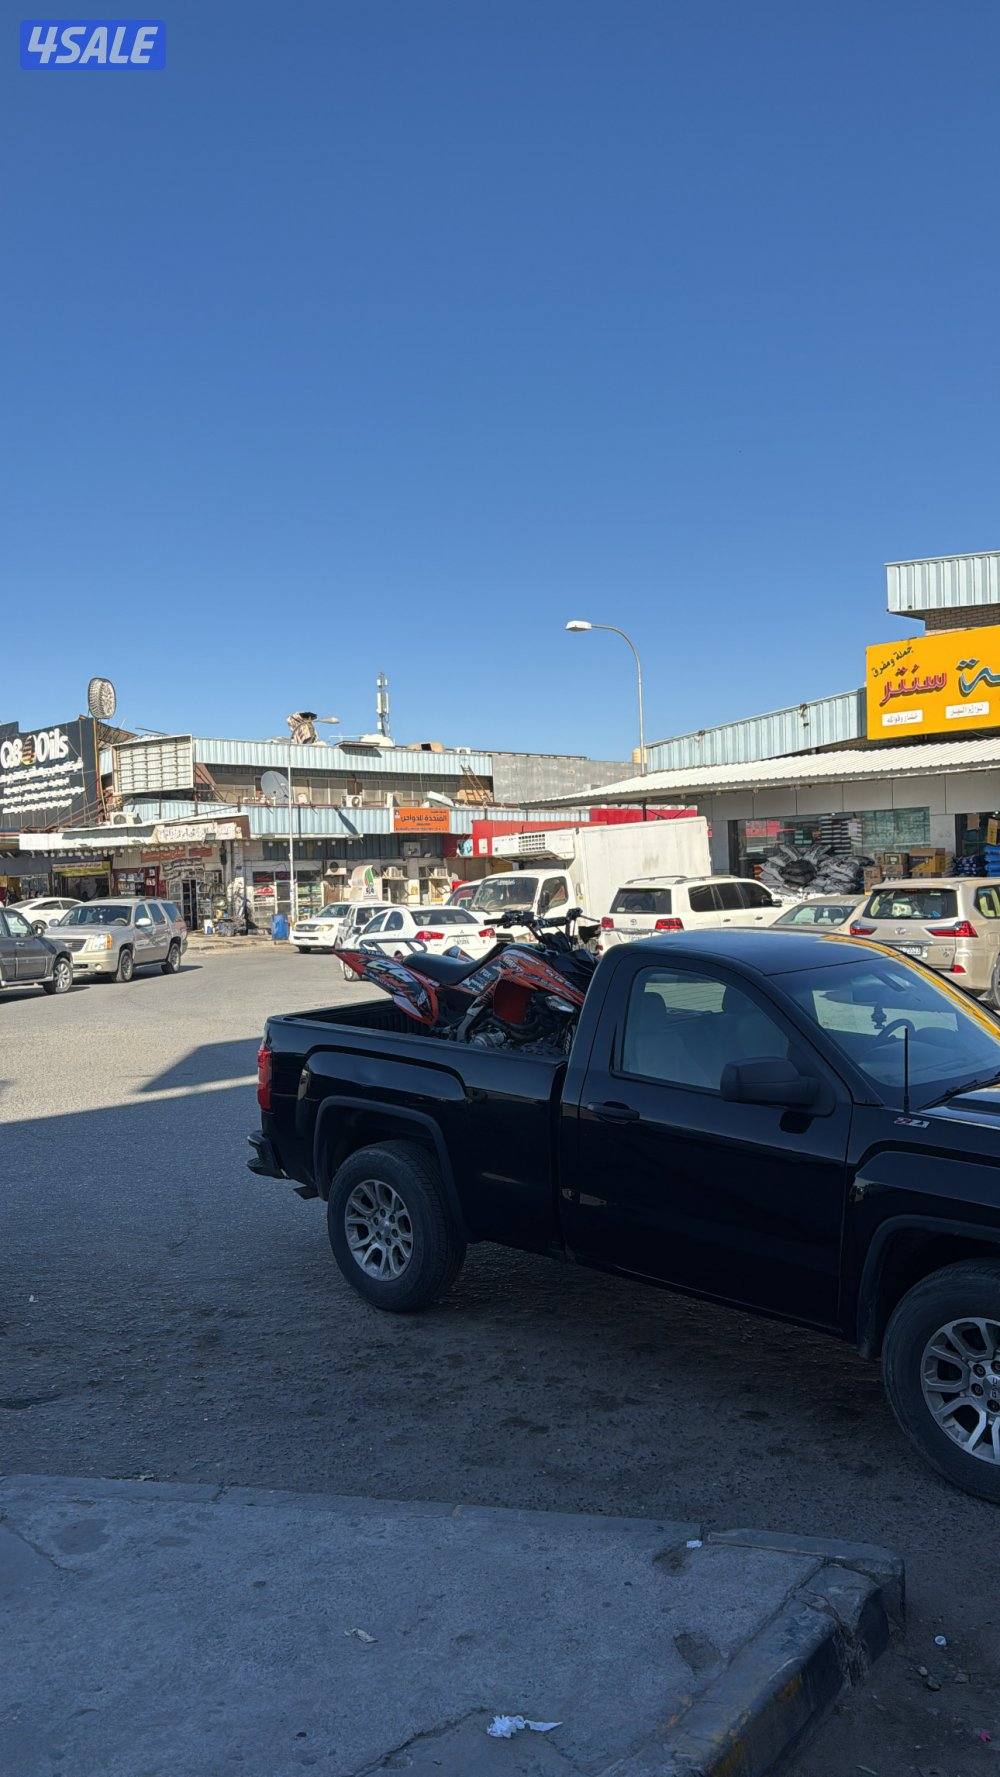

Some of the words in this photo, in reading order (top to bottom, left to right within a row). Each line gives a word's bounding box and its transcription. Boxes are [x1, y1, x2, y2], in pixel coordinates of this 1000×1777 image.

[892, 646, 914, 661] جملة
[871, 659, 896, 678] ومفرق
[879, 663, 948, 707] سنتر
[1, 738, 23, 769] Q8
[36, 727, 69, 763] Oils
[424, 814, 448, 822] المتحدة
